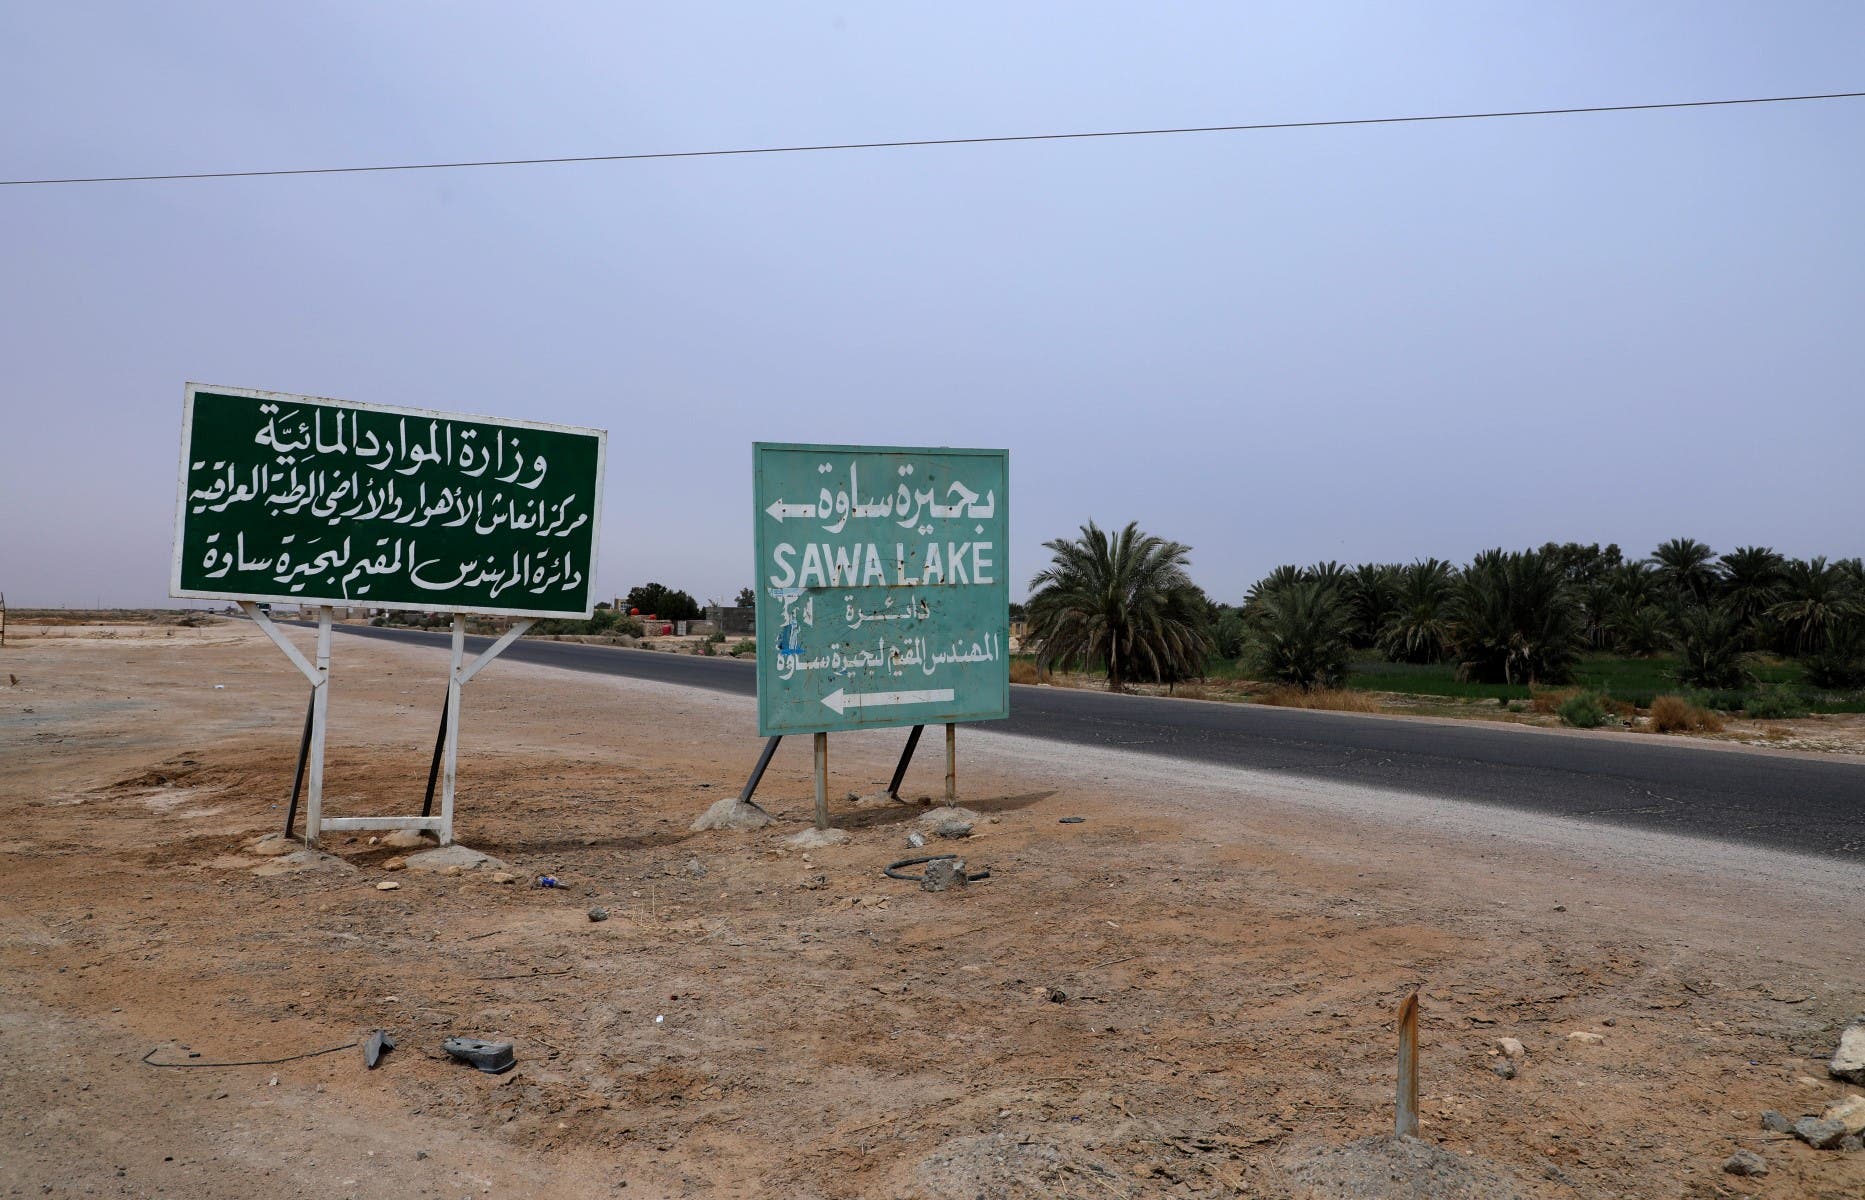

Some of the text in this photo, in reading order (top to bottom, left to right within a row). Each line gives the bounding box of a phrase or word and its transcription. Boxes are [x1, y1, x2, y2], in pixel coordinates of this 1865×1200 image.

[355, 417, 452, 476] الموارد
[459, 429, 548, 489] وزارة
[189, 460, 268, 514] العراقية
[264, 467, 324, 517] الرطبة
[311, 469, 403, 525] والأراضي
[393, 481, 483, 527] الأهوار
[817, 460, 995, 535] بحيرة ساوة
[536, 493, 588, 537] مركز
[202, 530, 273, 578] ساوة
[341, 537, 416, 599] المقيم
[410, 550, 530, 599] المهندس
[529, 548, 582, 594] دائرة
[770, 541, 994, 588] SAWA LAKE
[844, 594, 931, 630] دائرة
[831, 636, 884, 678] لبحيرة
[887, 635, 926, 677] المقيم
[922, 631, 999, 676] المهندس
